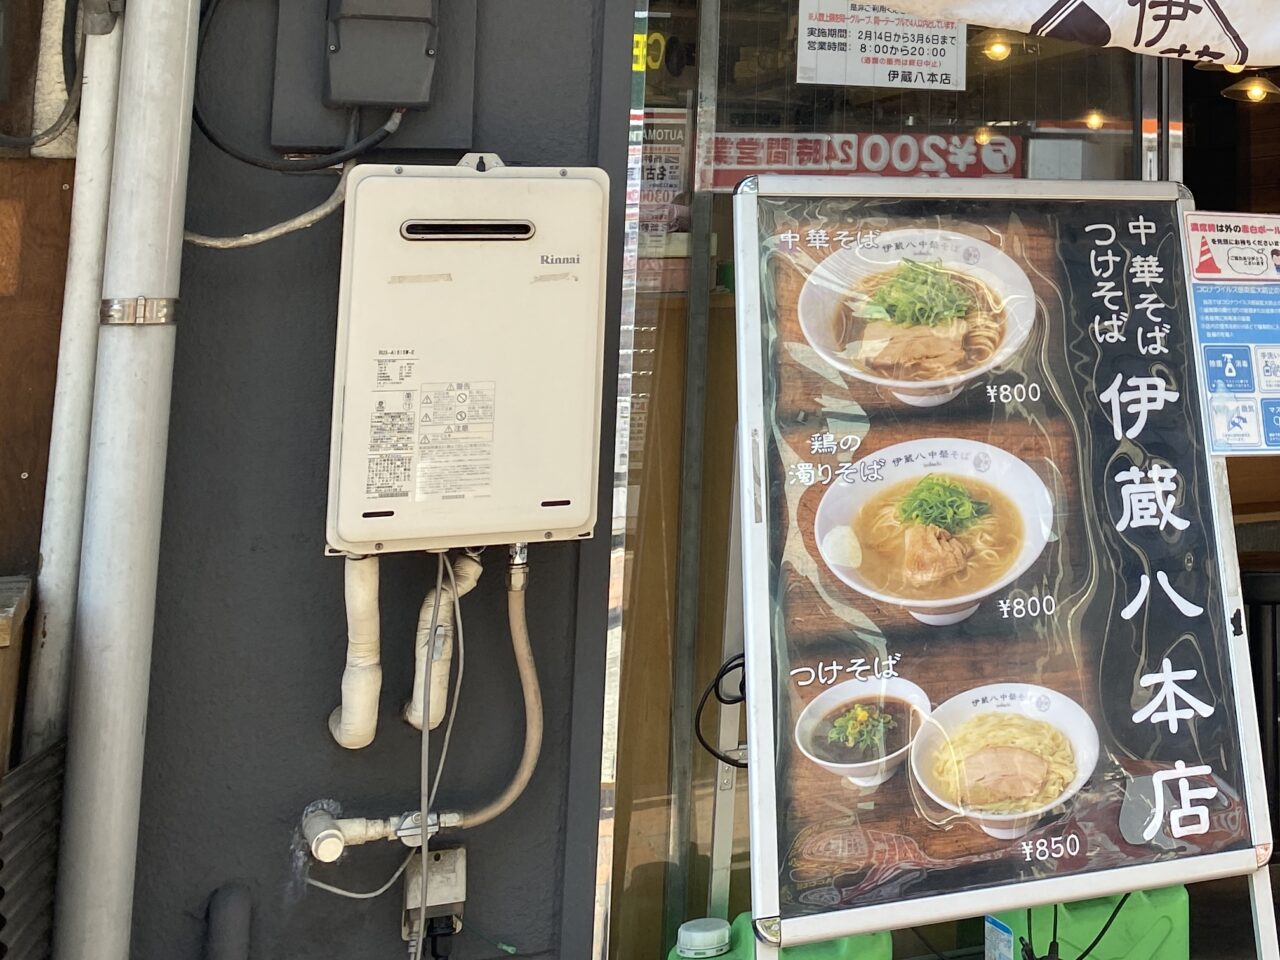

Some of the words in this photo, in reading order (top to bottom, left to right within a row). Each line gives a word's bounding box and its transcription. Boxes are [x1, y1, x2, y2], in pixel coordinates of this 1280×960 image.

[858, 30, 956, 45] 2月14日から3月6日まで
[888, 70, 951, 84] 伊蔵八本店
[780, 229, 882, 251] 中華そば
[540, 254, 580, 265] Rinnai
[1085, 223, 1127, 343] つけそば
[1128, 216, 1170, 356] 中華そば
[986, 383, 1041, 403] ¥800
[810, 433, 861, 455] 鶏の
[788, 458, 887, 488] 濁りそば
[998, 595, 1056, 619] ¥800
[1101, 372, 1219, 841] 伊蔵八本店
[790, 653, 901, 687] つけそば
[1021, 835, 1080, 862] ¥850
